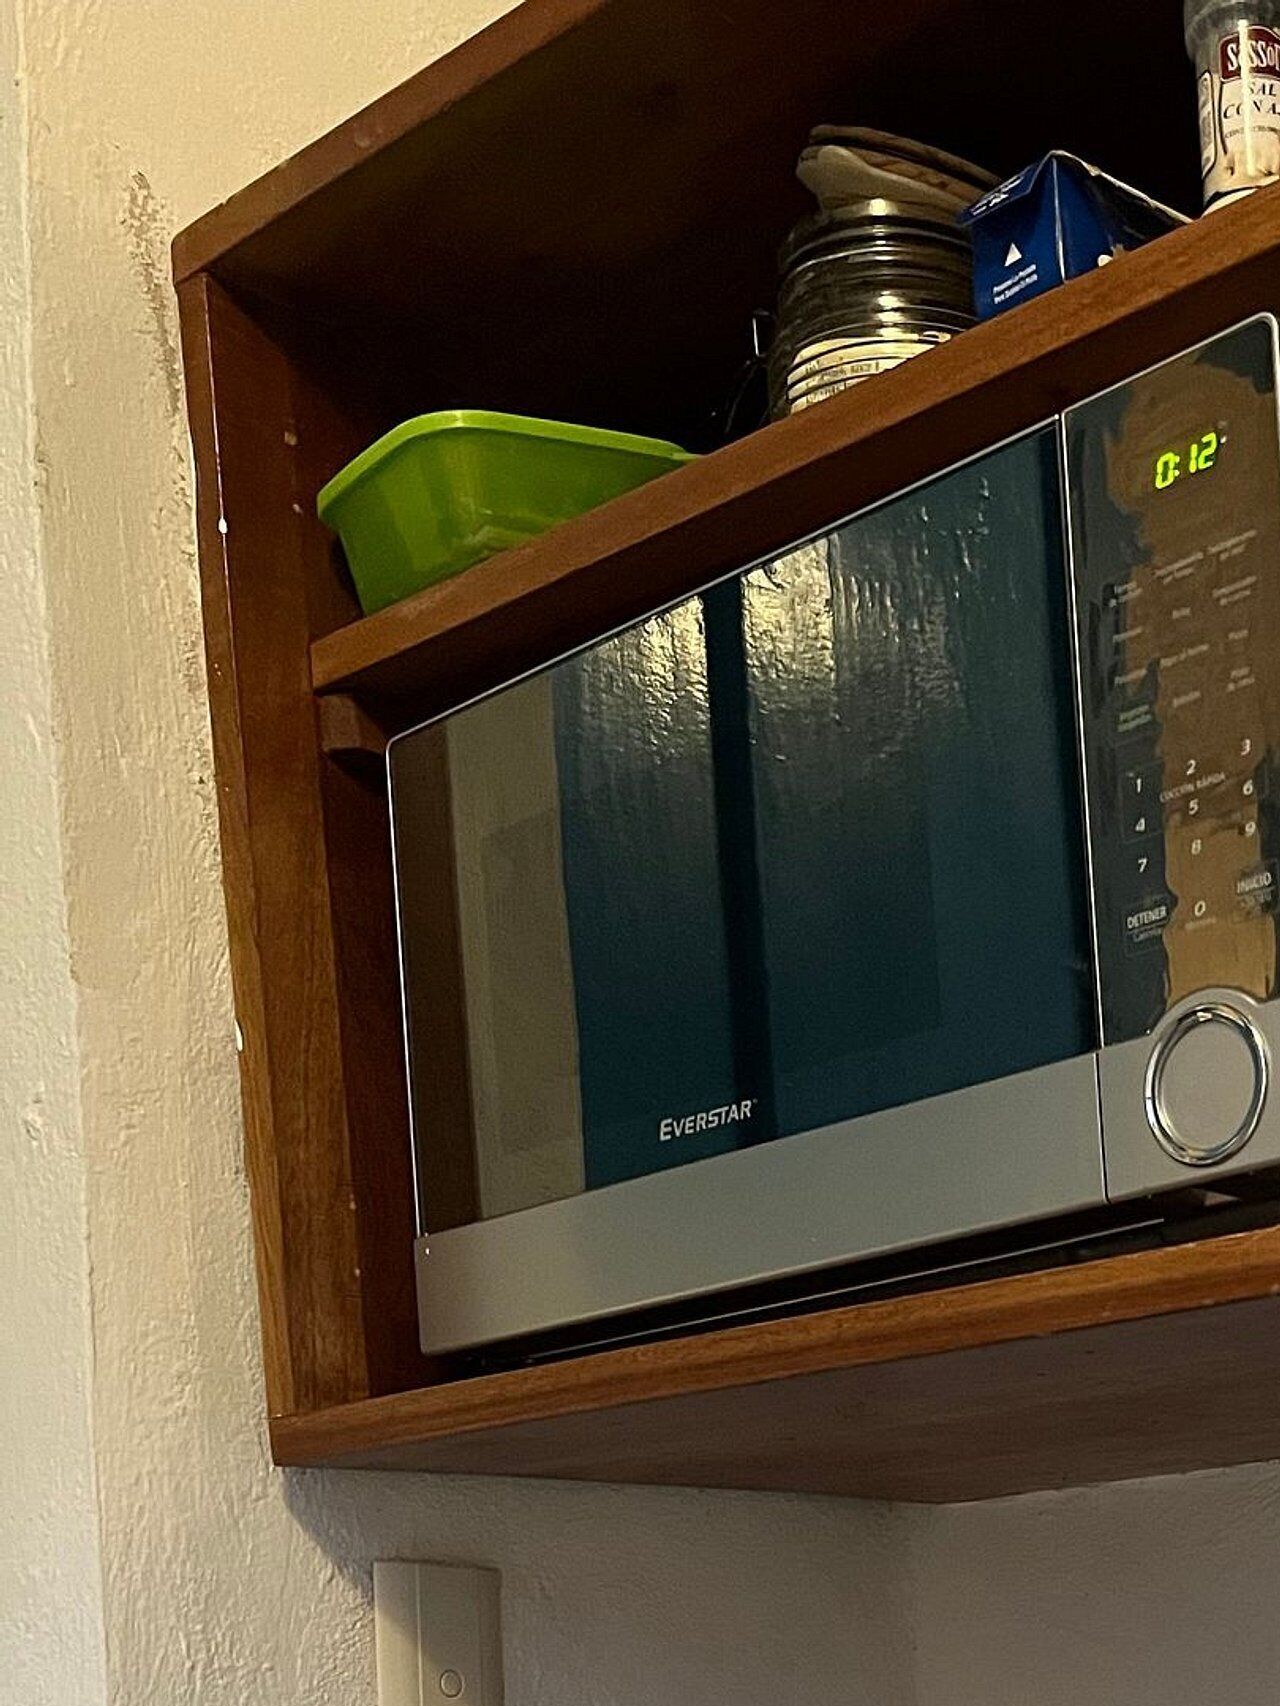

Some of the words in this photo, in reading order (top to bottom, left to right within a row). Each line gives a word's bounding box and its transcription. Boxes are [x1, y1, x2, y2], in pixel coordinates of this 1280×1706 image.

[1155, 431, 1218, 490] 0:12
[1240, 738, 1251, 757] 3
[1186, 759, 1197, 776] 2
[1134, 777, 1143, 794] 1
[1242, 779, 1254, 796] 6
[1188, 799, 1199, 816] 5
[1245, 821, 1257, 838] 9
[1137, 857, 1149, 873] 7
[1194, 899, 1207, 917] 0
[660, 1099, 754, 1141] EVERSTAR
